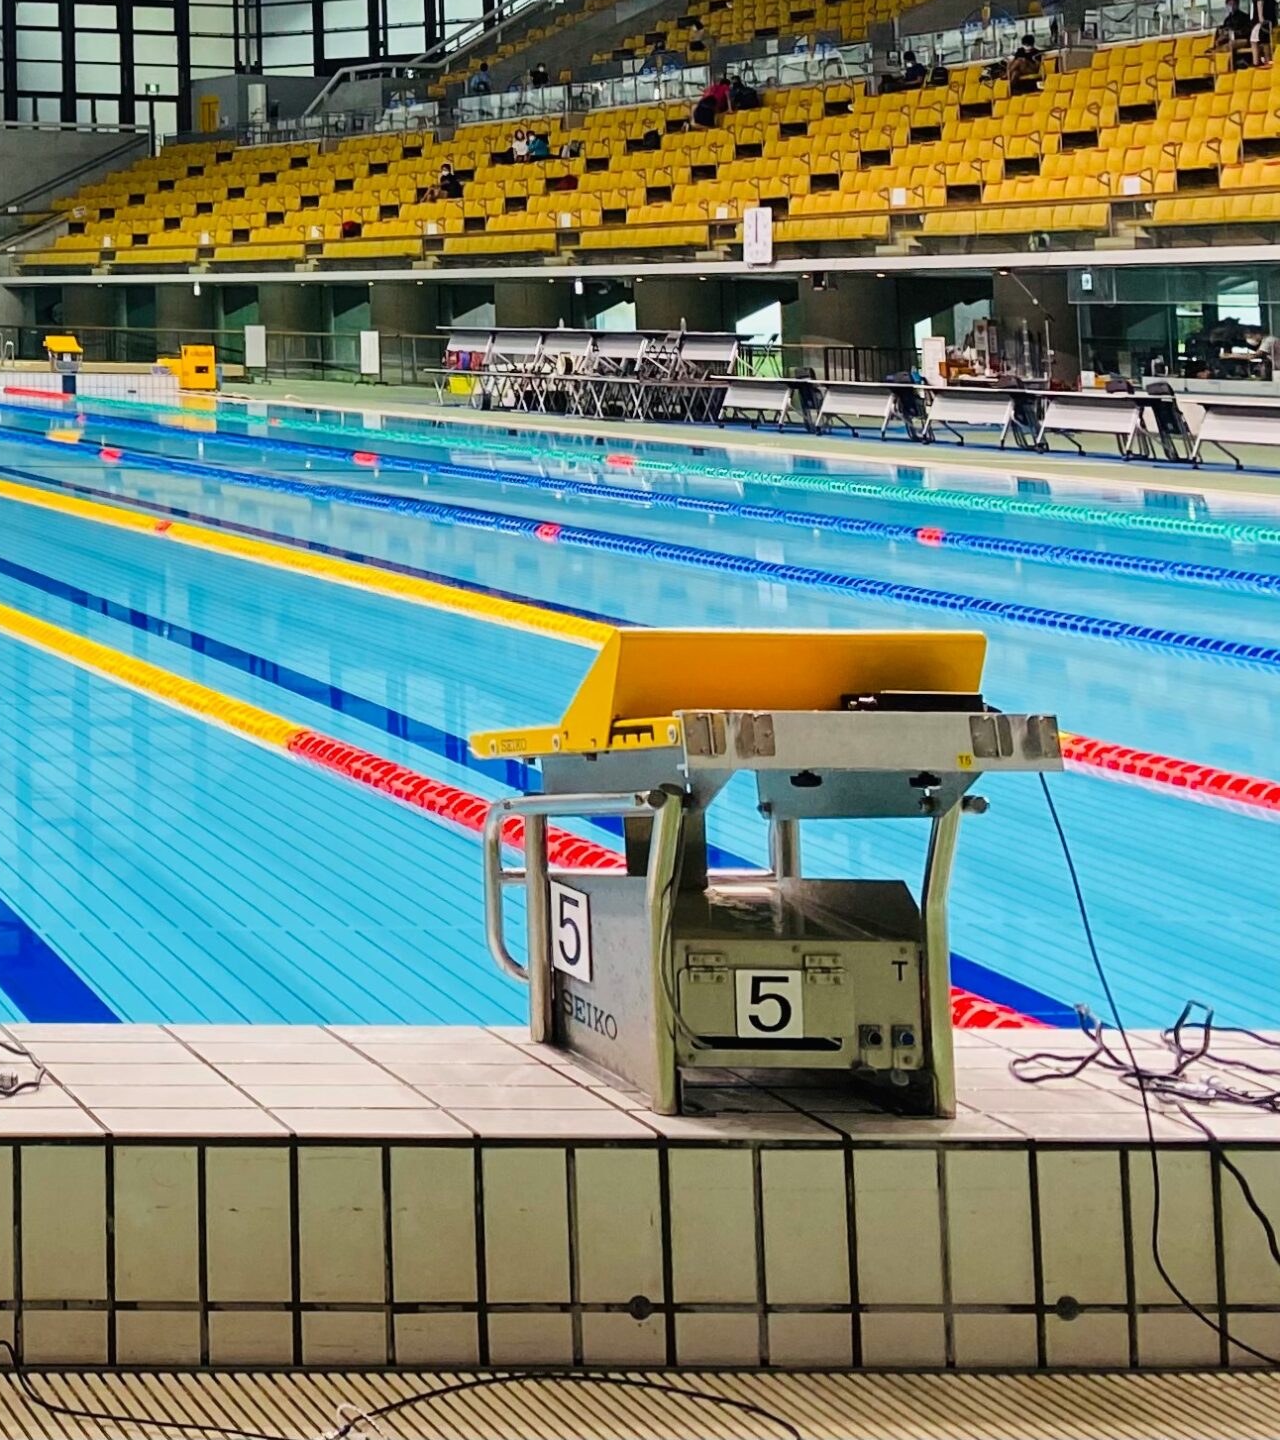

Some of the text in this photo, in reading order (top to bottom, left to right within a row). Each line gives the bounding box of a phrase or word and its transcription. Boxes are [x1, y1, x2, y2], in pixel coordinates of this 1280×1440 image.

[501, 738, 527, 753] SEIKO
[558, 892, 581, 966] 5
[891, 961, 908, 982] T
[562, 989, 618, 1041] SEIKO
[748, 976, 792, 1033] 5
